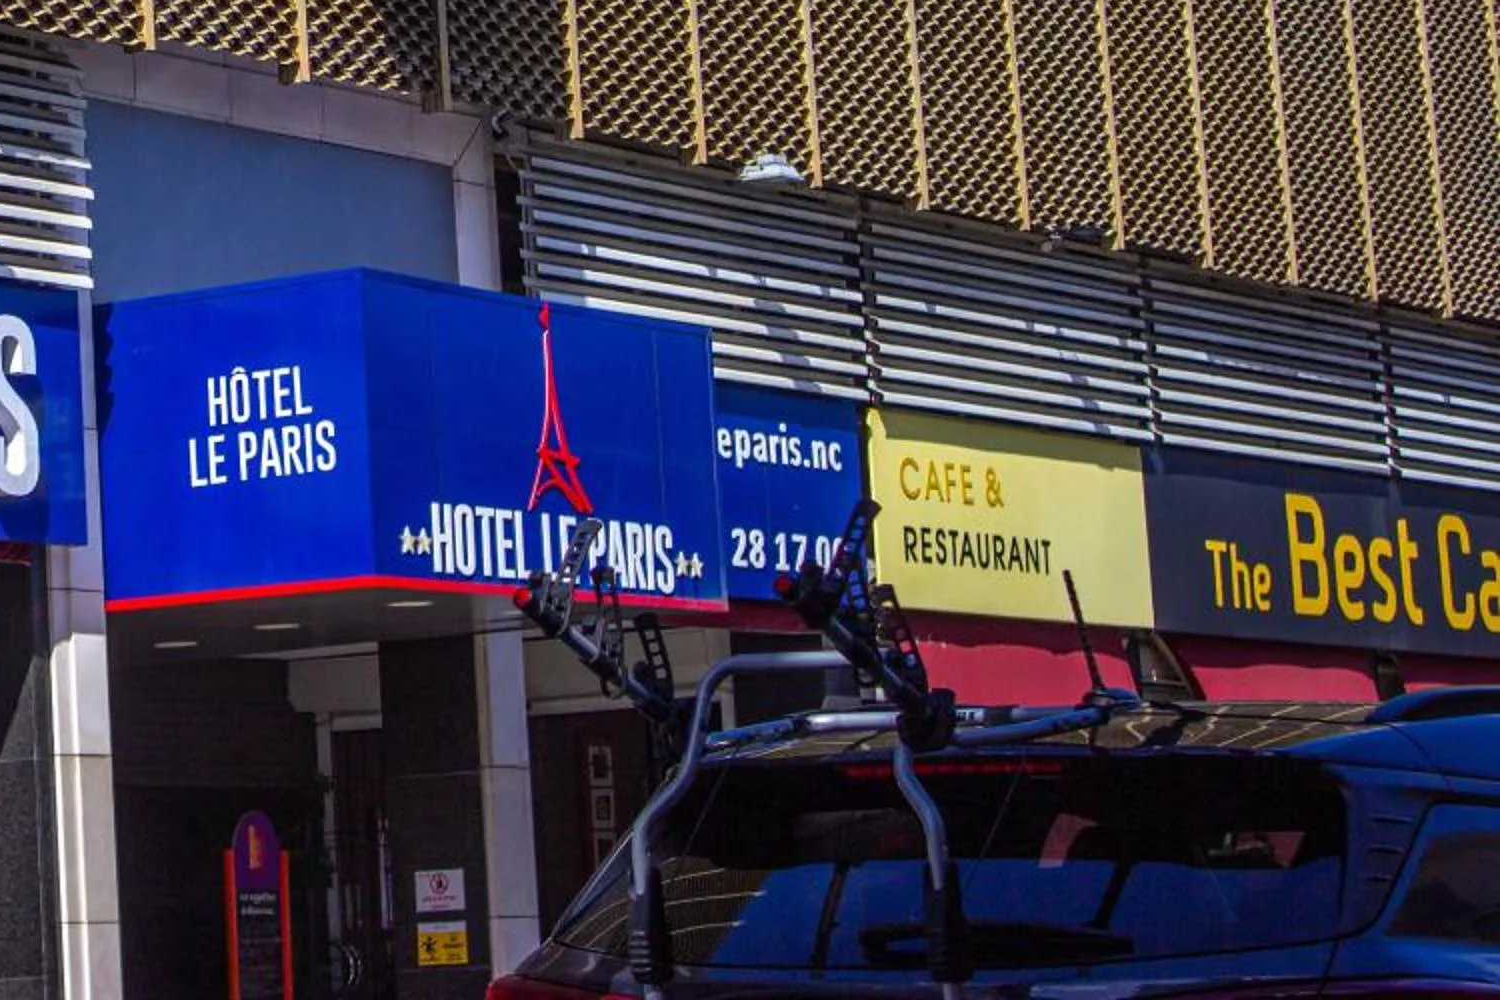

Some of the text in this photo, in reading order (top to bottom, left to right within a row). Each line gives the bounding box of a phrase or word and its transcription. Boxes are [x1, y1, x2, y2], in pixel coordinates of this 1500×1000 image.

[207, 365, 314, 428] HÔTEL
[188, 419, 337, 488] LE PARIS
[717, 423, 843, 471] eparis.nc
[900, 457, 1005, 508] CAFE &
[430, 501, 532, 579] HOTEL
[587, 517, 676, 595] PARIS
[731, 527, 767, 569] 28
[775, 533, 808, 573] 17
[903, 525, 1052, 575] RESTAURANT
[1205, 539, 1271, 611] The
[1285, 493, 1425, 625] Best
